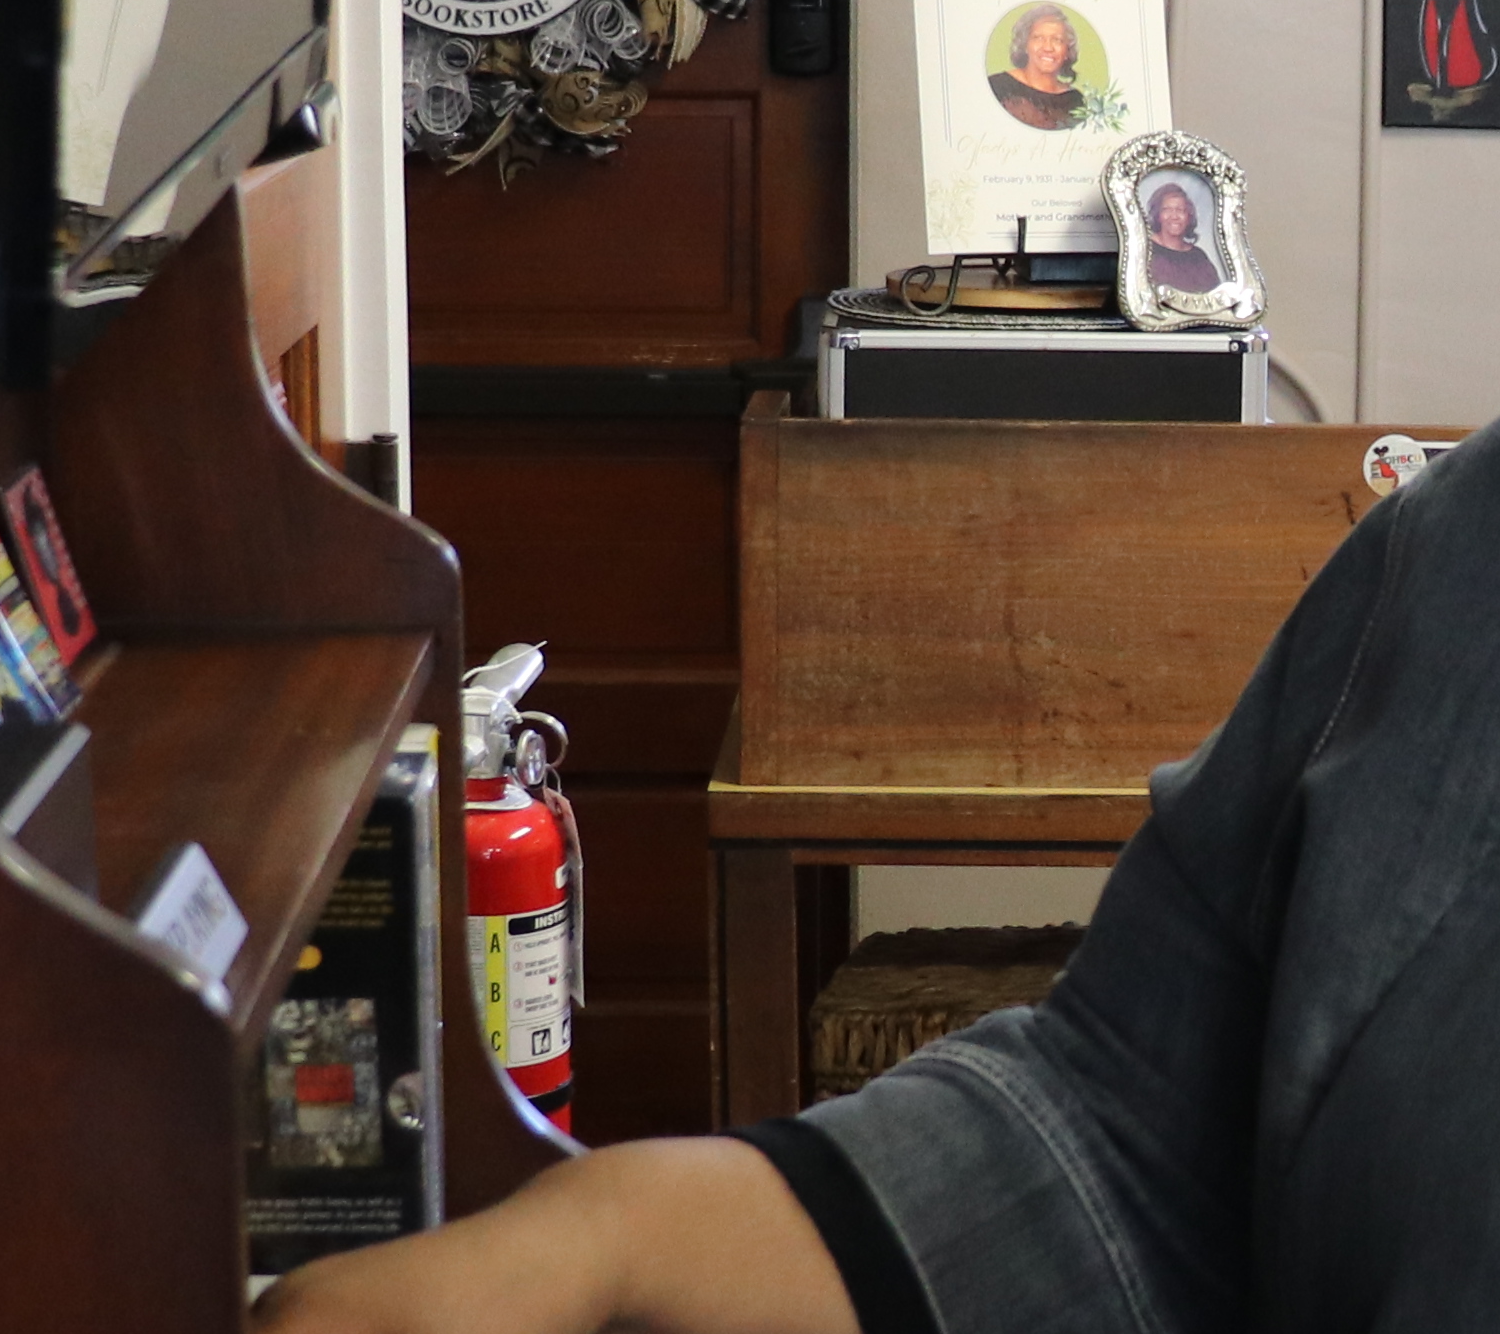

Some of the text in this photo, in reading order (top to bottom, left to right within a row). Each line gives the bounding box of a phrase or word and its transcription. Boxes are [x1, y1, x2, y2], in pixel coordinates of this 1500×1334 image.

[982, 174, 1024, 186] February
[1060, 175, 1096, 186] January
[1031, 199, 1083, 208] Our Beloved
[996, 213, 1113, 223] Motr and Grandmoth
[489, 932, 501, 954] A
[491, 982, 501, 1003] B
[491, 1030, 501, 1052] C
